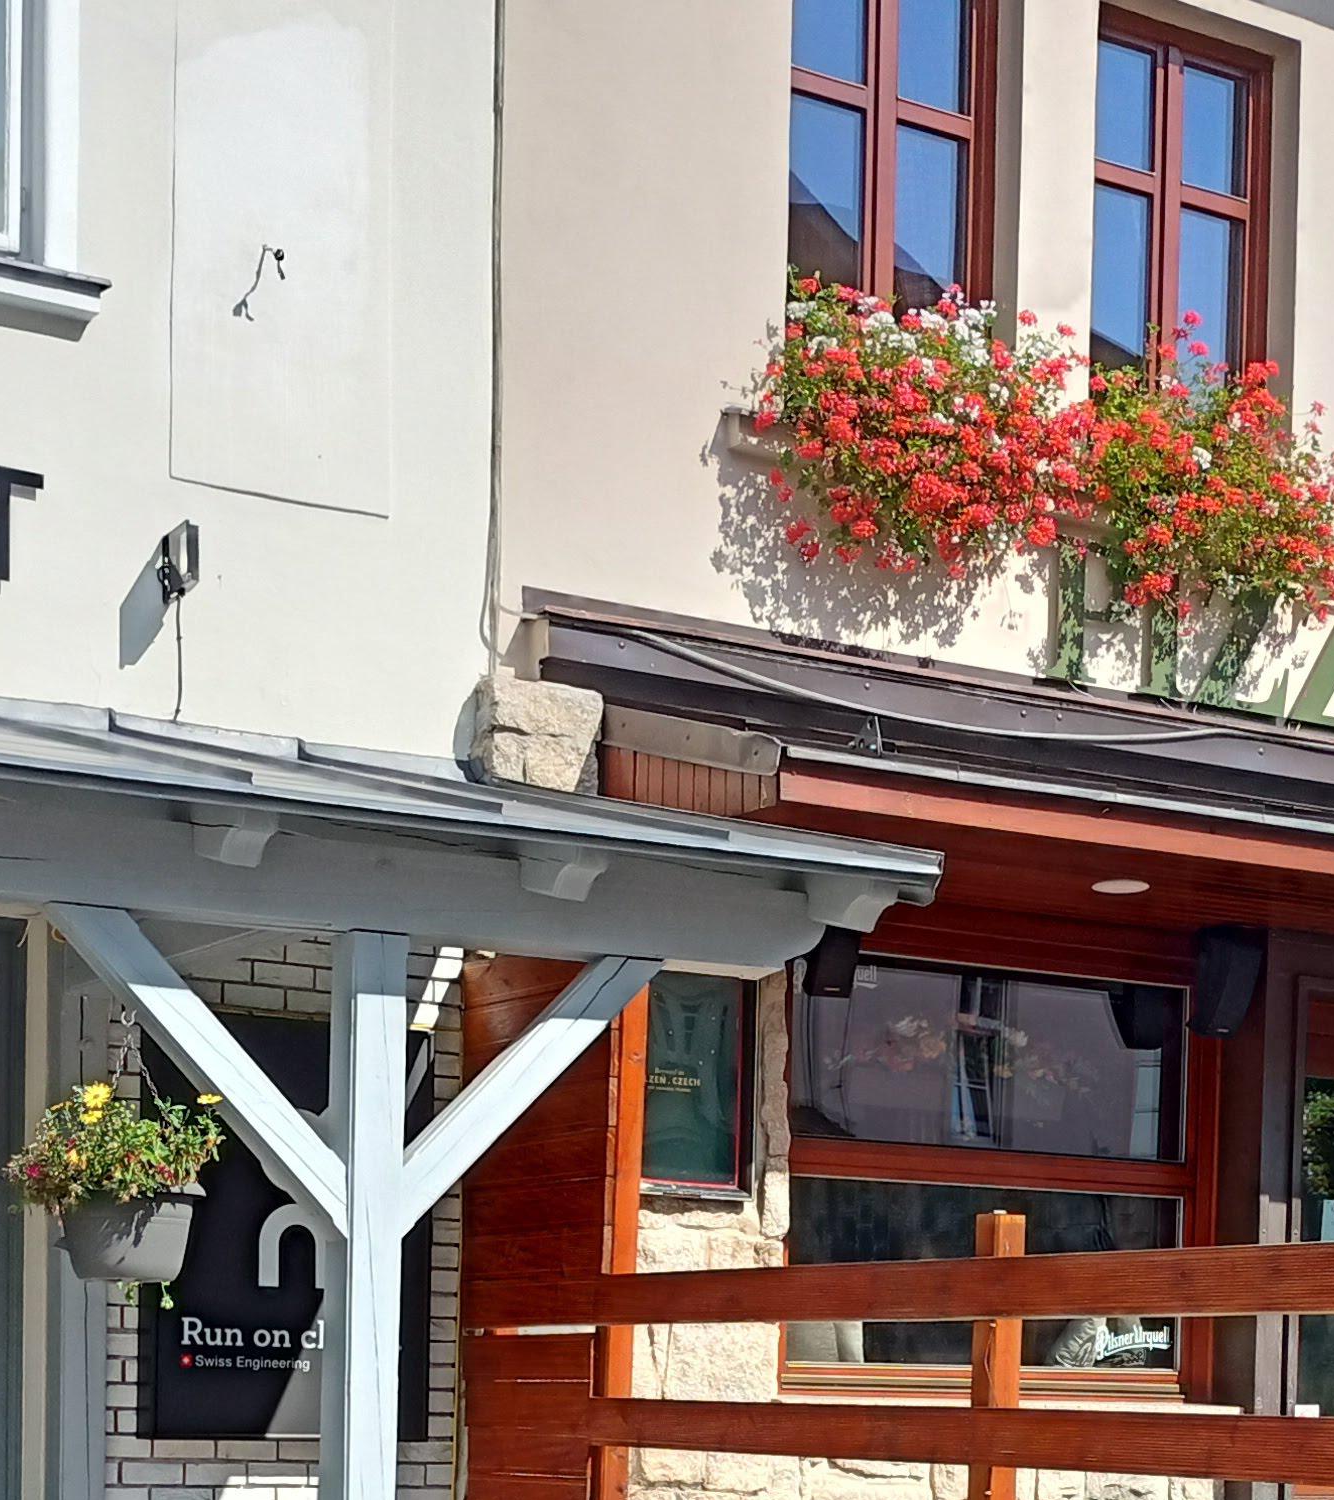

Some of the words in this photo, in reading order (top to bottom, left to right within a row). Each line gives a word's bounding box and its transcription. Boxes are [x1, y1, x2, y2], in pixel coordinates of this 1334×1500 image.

[181, 1317, 244, 1346] Run
[253, 1328, 292, 1347] on
[1095, 1325, 1134, 1361] Pilsner
[1132, 1324, 1170, 1351] Urquell
[195, 1355, 232, 1368] Swiss
[237, 1356, 311, 1372] Engineering
